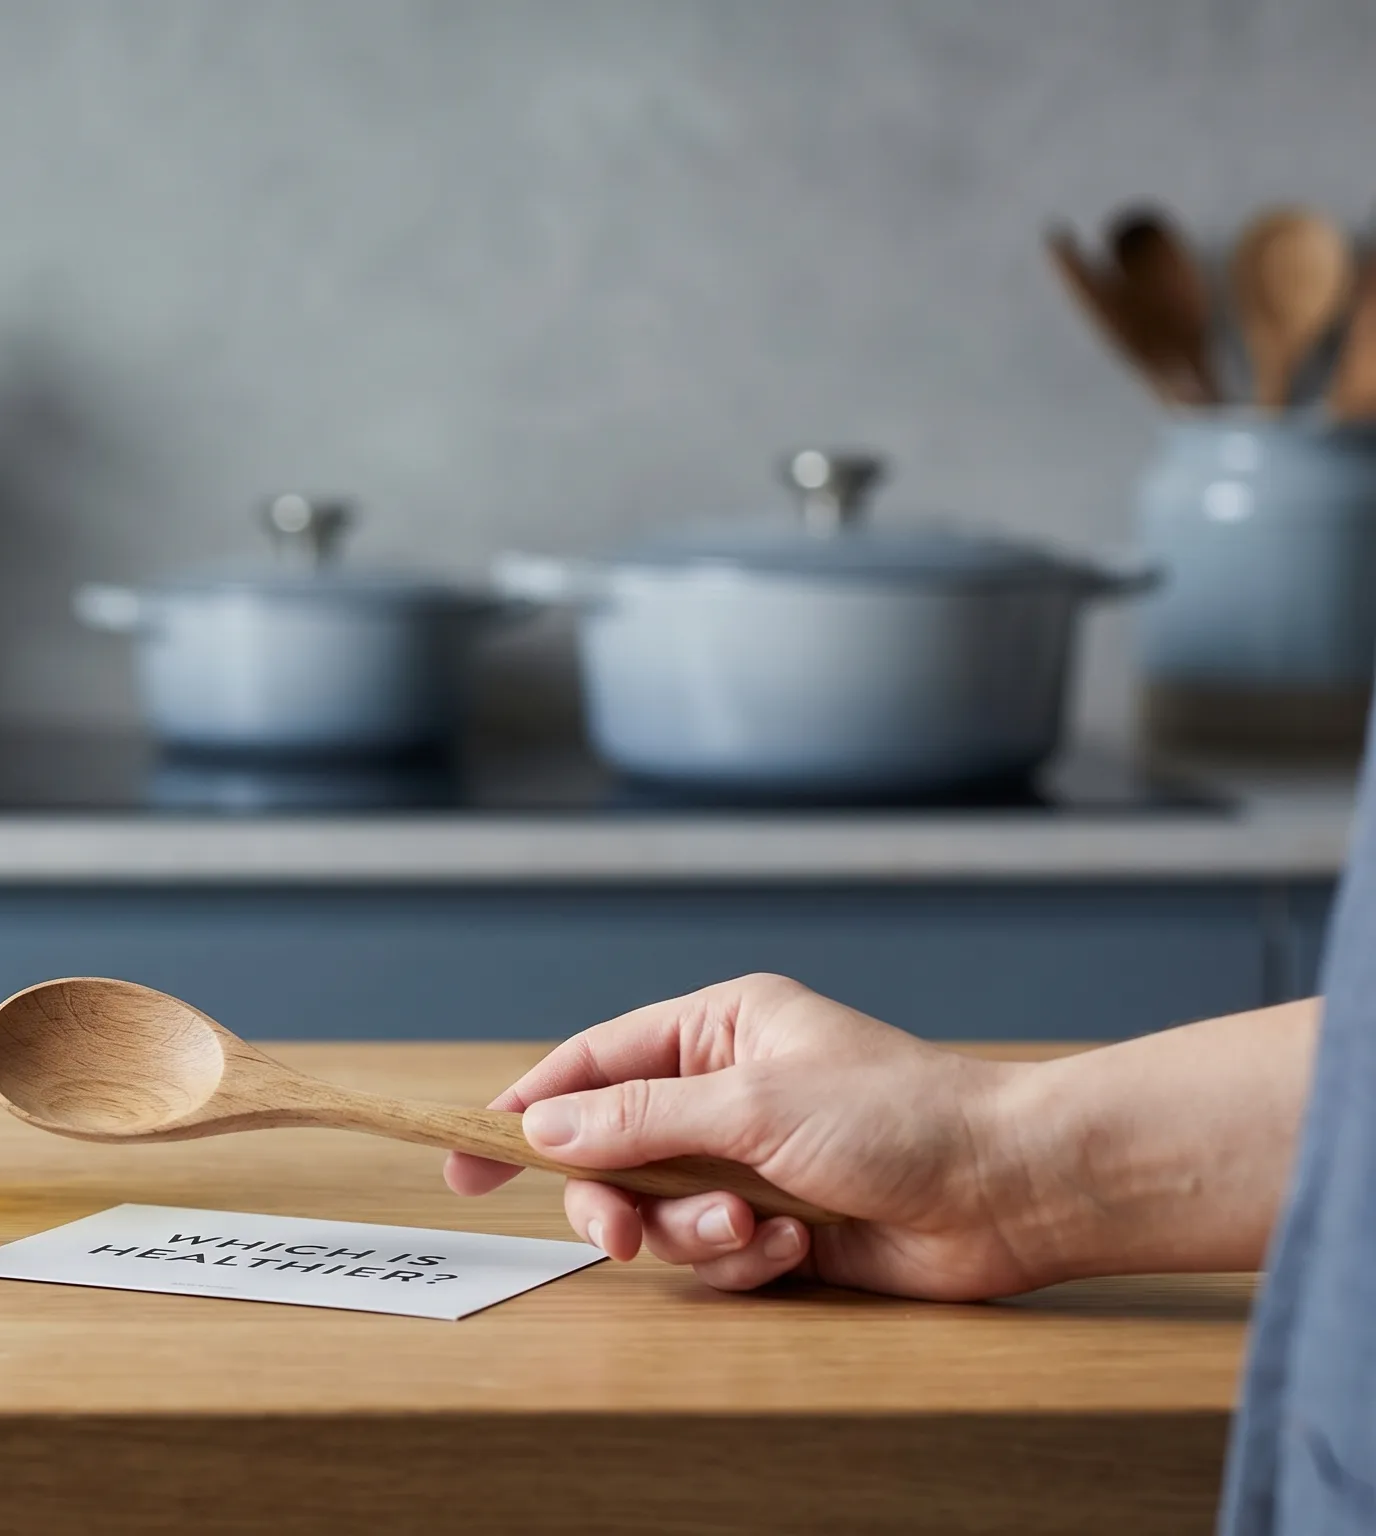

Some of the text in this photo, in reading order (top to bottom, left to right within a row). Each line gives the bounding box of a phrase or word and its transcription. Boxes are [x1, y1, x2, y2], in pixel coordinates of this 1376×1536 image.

[87, 1244, 459, 1285] HEALTHIER?
[167, 1233, 447, 1266] WHICH IS
